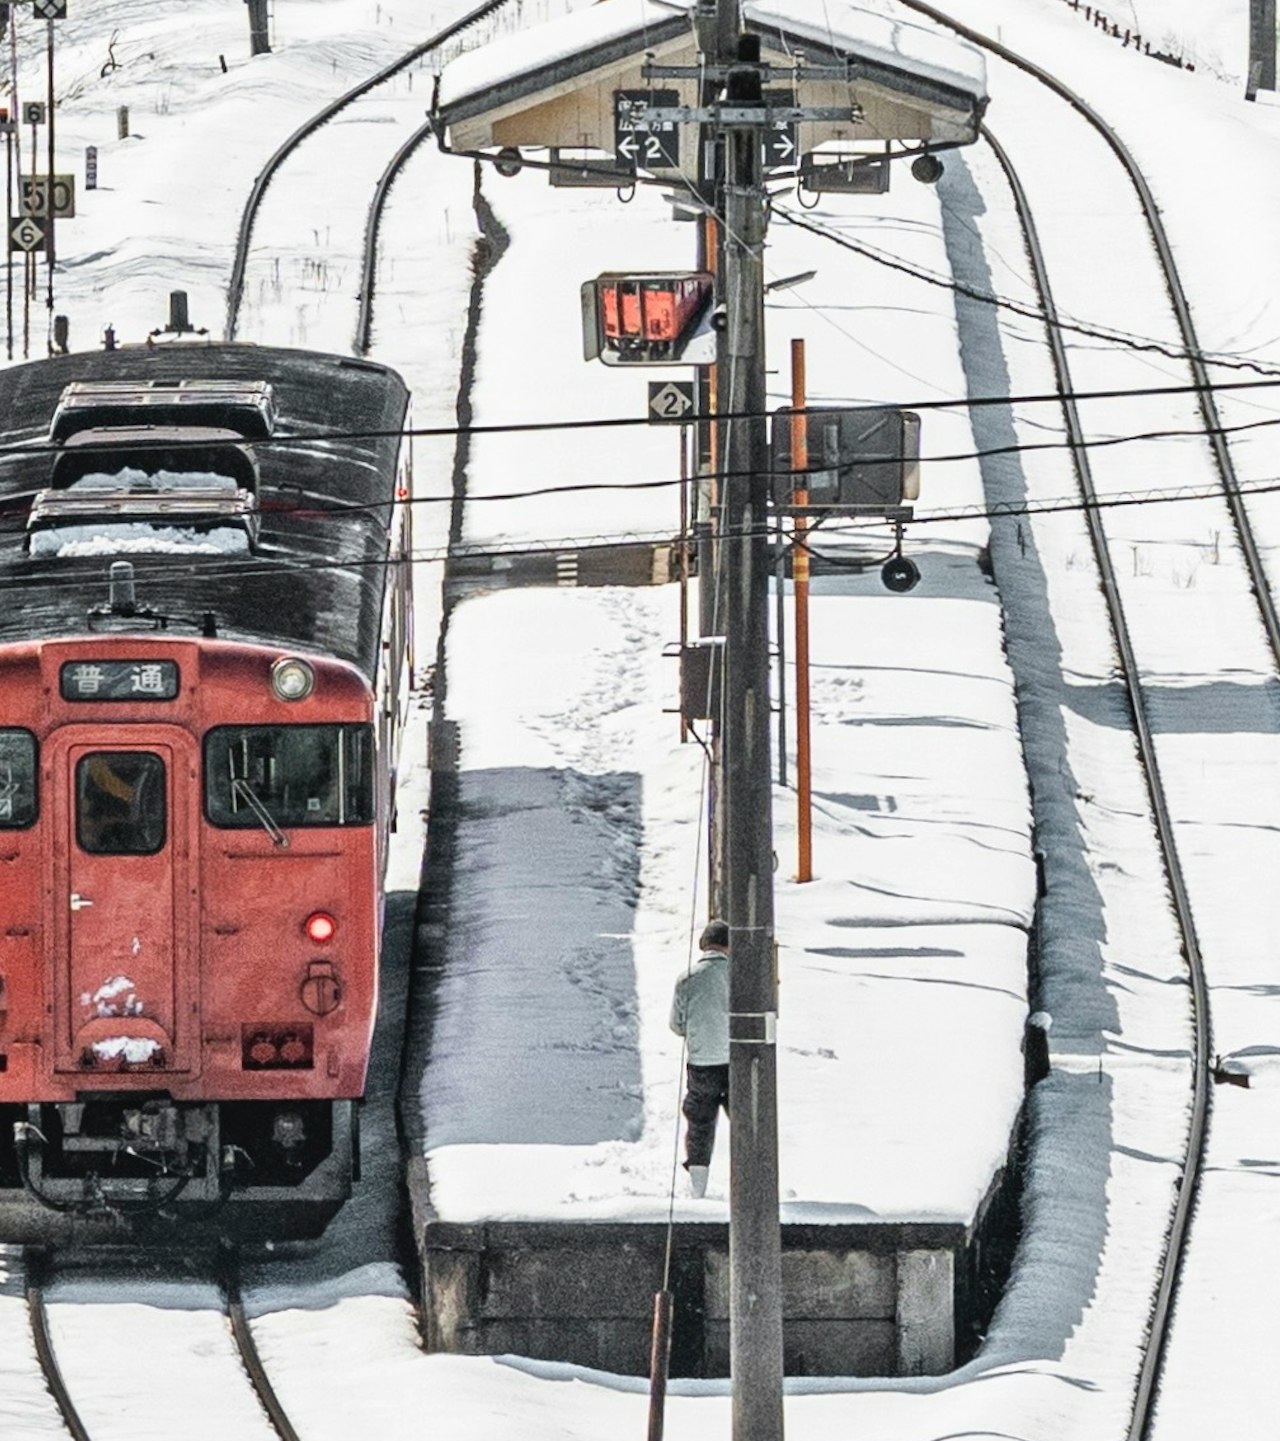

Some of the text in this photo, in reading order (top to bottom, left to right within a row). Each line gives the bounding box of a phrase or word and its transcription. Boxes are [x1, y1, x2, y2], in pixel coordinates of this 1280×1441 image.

[28, 104, 40, 121] 6
[644, 136, 661, 158] 2
[23, 182, 70, 211] 50
[21, 226, 34, 243] 6
[72, 664, 164, 693] 普通
